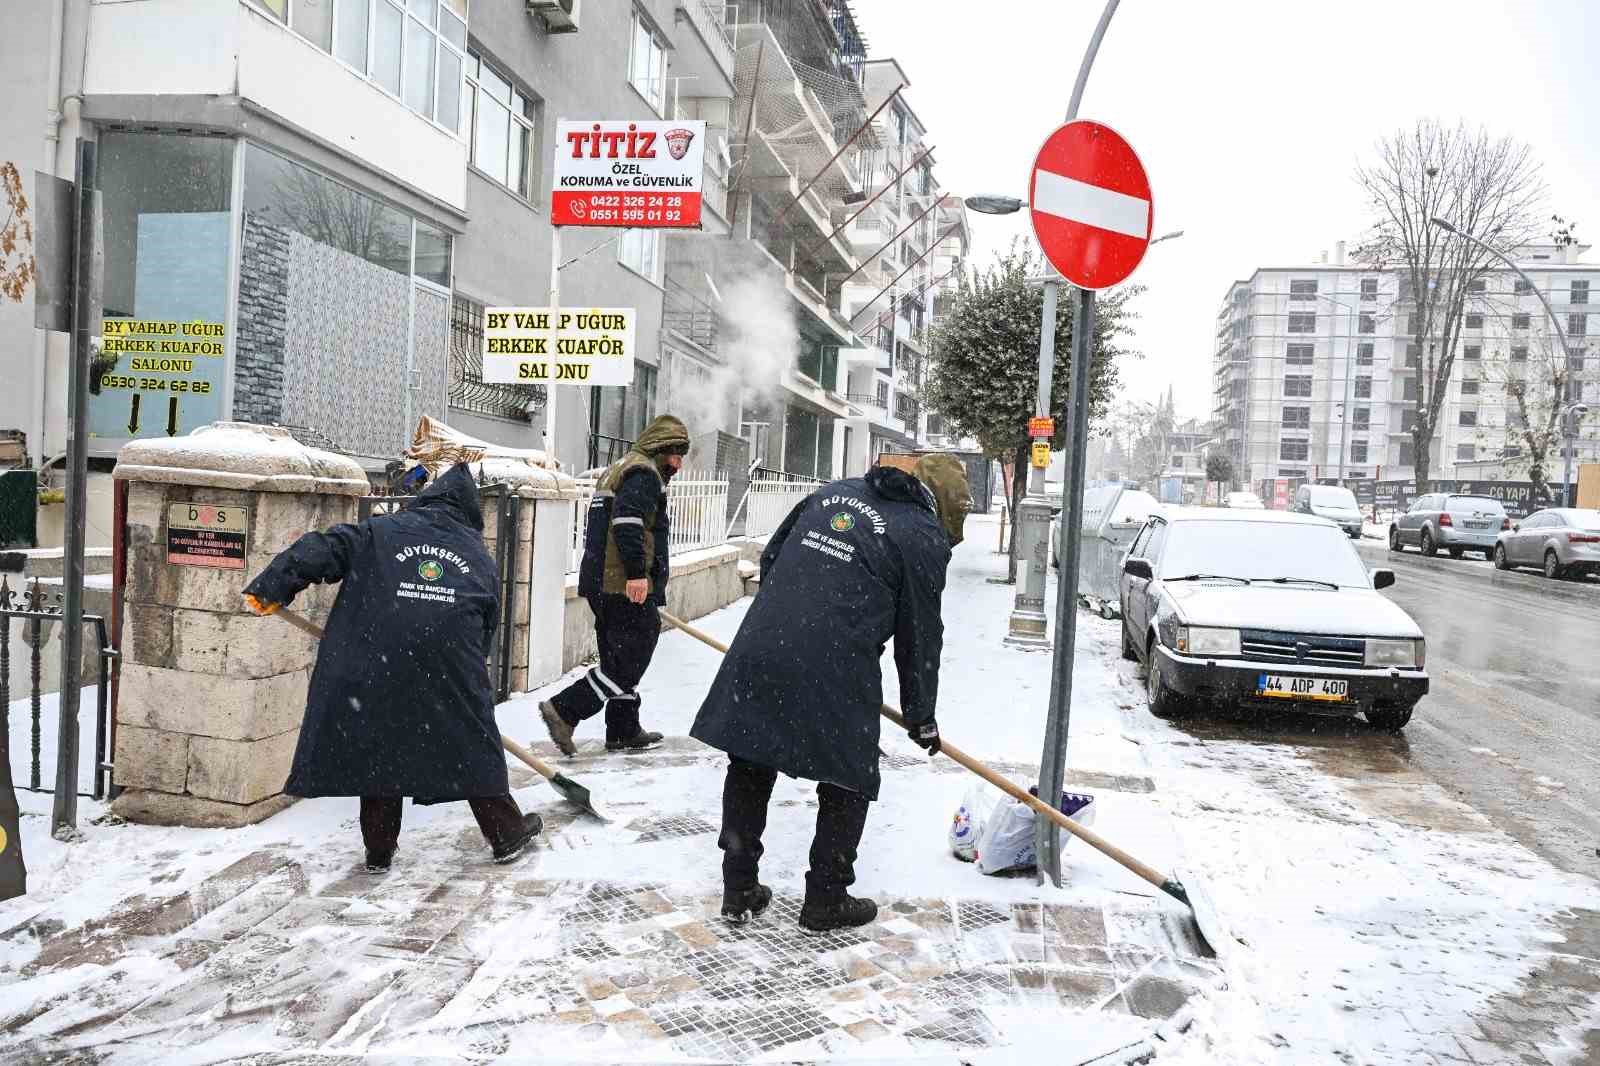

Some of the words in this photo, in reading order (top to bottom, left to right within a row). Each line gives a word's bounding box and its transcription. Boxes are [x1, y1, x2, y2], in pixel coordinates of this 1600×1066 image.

[567, 123, 657, 159] TİTİZ
[612, 162, 642, 175] ÖZEL
[560, 176, 613, 187] KORUMA
[616, 179, 630, 187] ve
[632, 174, 693, 187] GÜVENLİK
[591, 196, 620, 207] 0422
[623, 196, 645, 207] 326
[648, 197, 664, 207] 24
[667, 197, 682, 207] 28
[590, 210, 618, 220] 0551
[622, 210, 644, 220] 595
[648, 211, 661, 220] 01
[665, 211, 681, 221] 92
[103, 321, 124, 333] BY
[127, 322, 177, 335] VAHAP
[487, 313, 509, 329] BY
[514, 313, 571, 330] VAHP
[103, 339, 156, 352] ERKEK
[160, 338, 224, 355] KUAFÖR
[487, 338, 547, 354] ERKEK
[132, 358, 193, 372] SALONU
[102, 375, 136, 389] 0530
[140, 378, 166, 390] 324
[170, 380, 188, 392] 62
[191, 381, 210, 393] 82
[1505, 487, 1530, 501] YAPI
[395, 544, 470, 574] BÜYÜKŞEHİR
[1266, 676, 1282, 690] 44
[1290, 678, 1314, 693] ADP
[1322, 680, 1346, 694] 400
